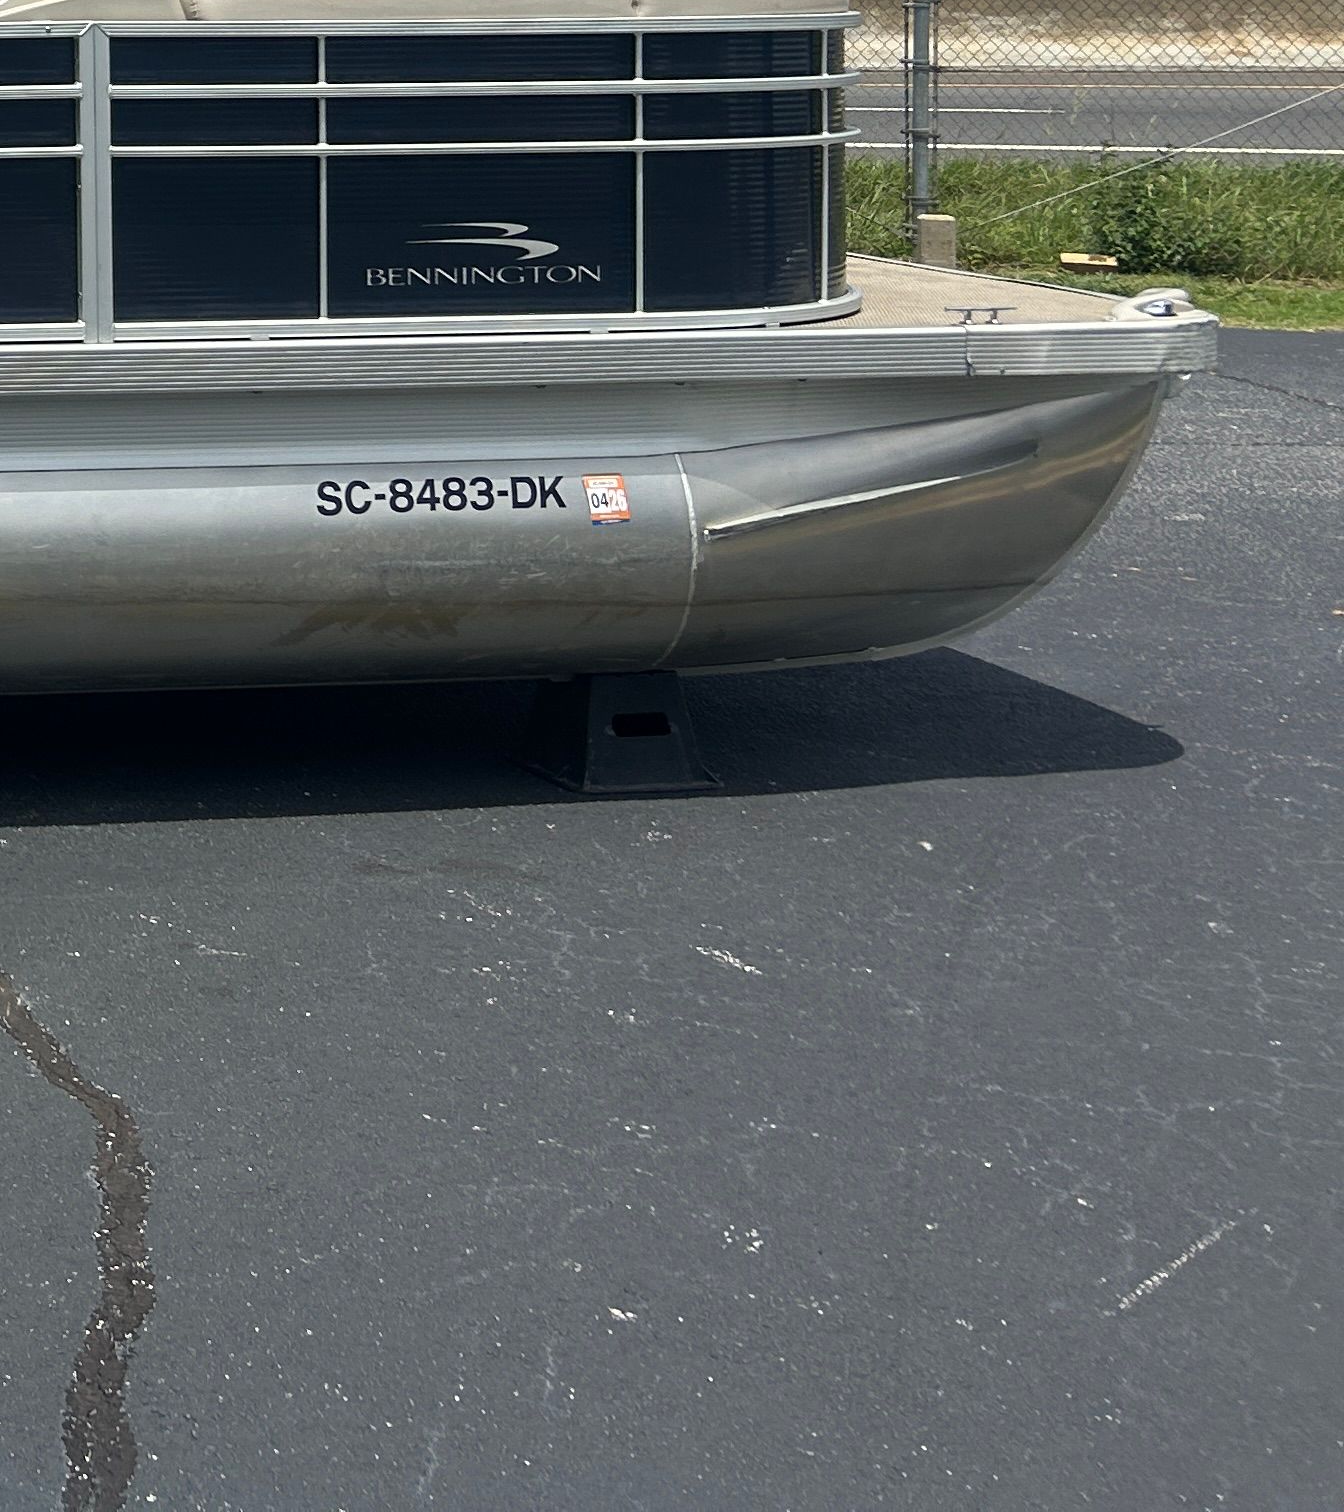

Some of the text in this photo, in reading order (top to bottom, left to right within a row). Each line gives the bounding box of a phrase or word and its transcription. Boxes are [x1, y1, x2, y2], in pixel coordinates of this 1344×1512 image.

[366, 264, 601, 287] BENNINGTON
[316, 475, 568, 516] SC-8483-DK
[591, 492, 609, 509] 04
